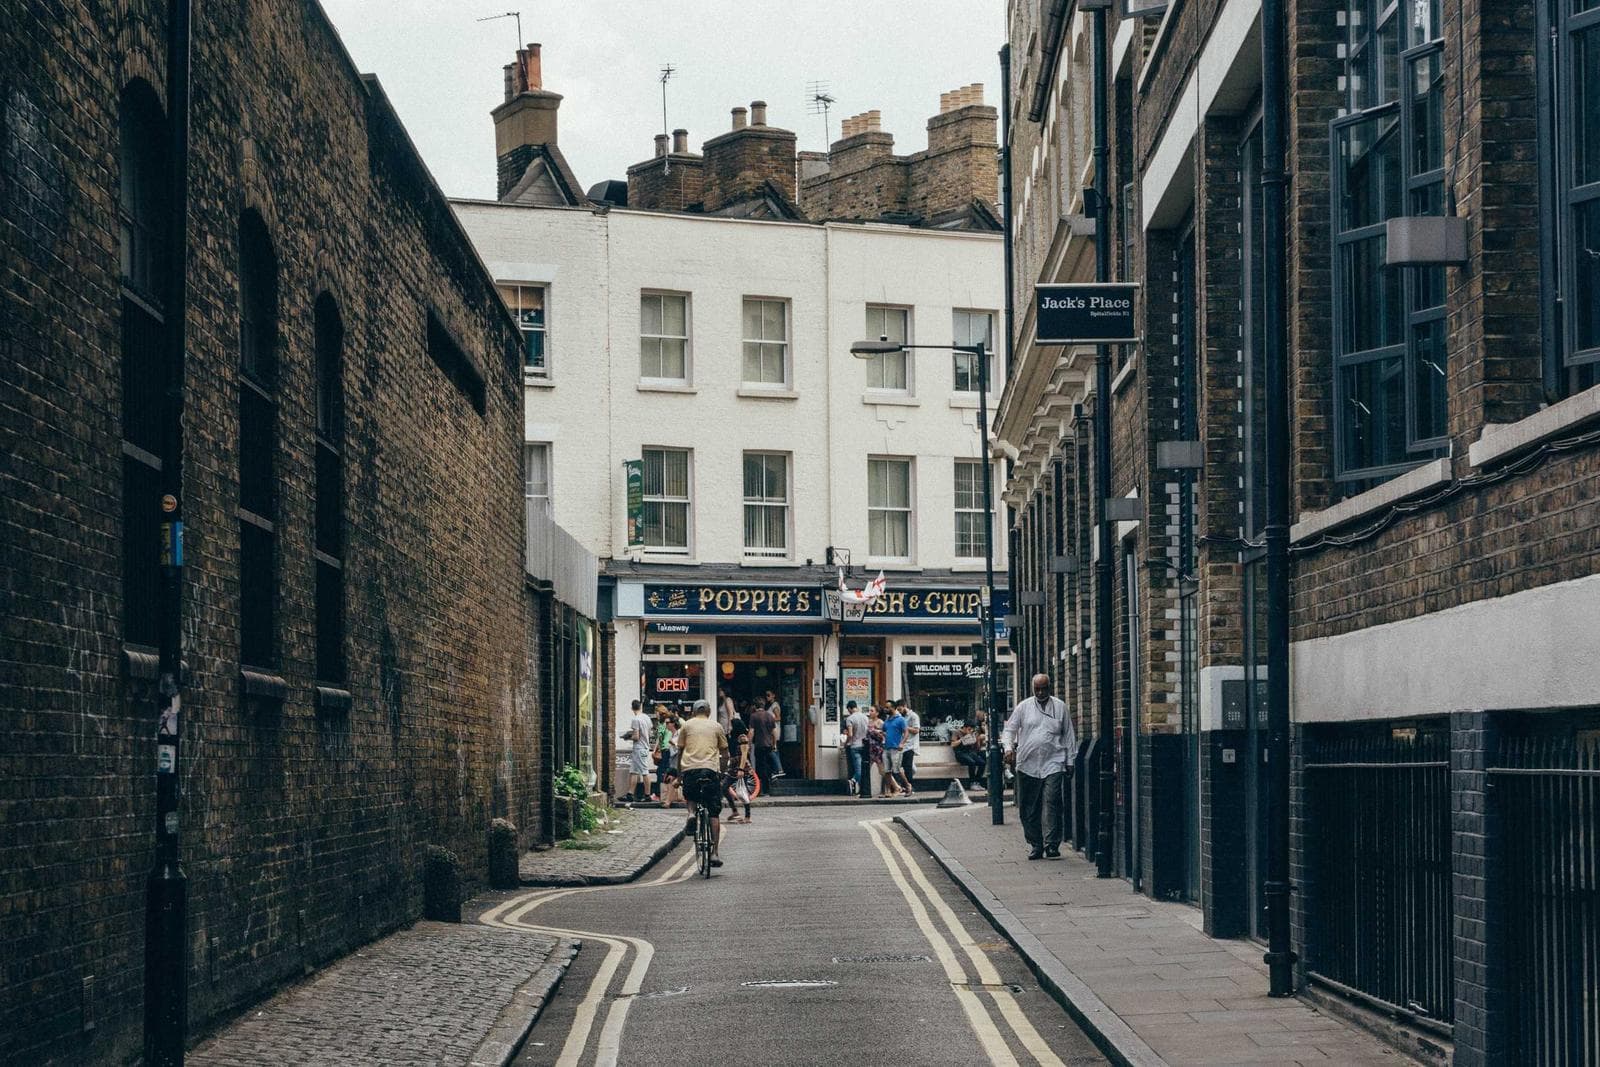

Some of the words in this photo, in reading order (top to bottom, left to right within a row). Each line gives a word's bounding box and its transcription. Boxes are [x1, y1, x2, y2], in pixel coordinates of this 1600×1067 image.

[1041, 296, 1086, 309] Jack's
[1089, 296, 1130, 309] Place
[699, 587, 810, 612] POPPIE'S
[908, 594, 921, 610] &
[656, 623, 690, 634] Takeaway
[914, 664, 950, 672] WELCOME
[951, 664, 962, 672] TO
[658, 679, 688, 691] OPEN
